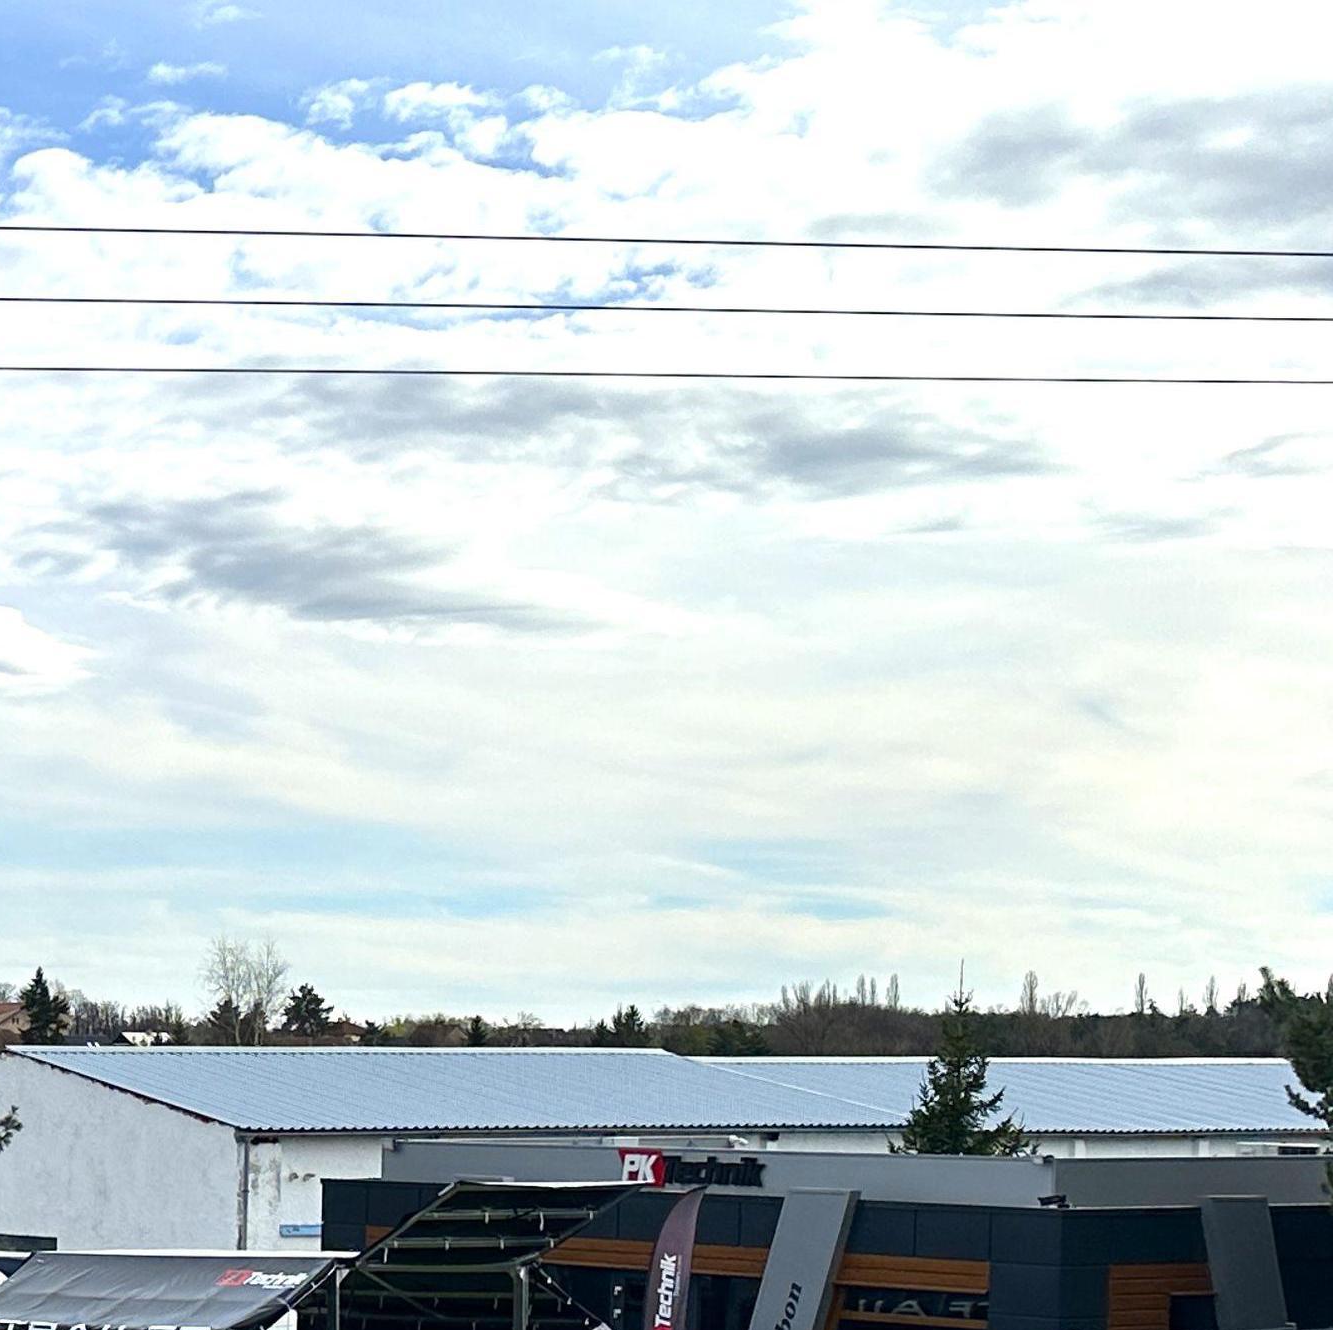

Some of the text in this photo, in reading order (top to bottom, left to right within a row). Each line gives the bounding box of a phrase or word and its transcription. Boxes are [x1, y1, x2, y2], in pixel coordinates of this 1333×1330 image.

[622, 1153, 767, 1187] PK Technik
[654, 1253, 677, 1328] Technik
